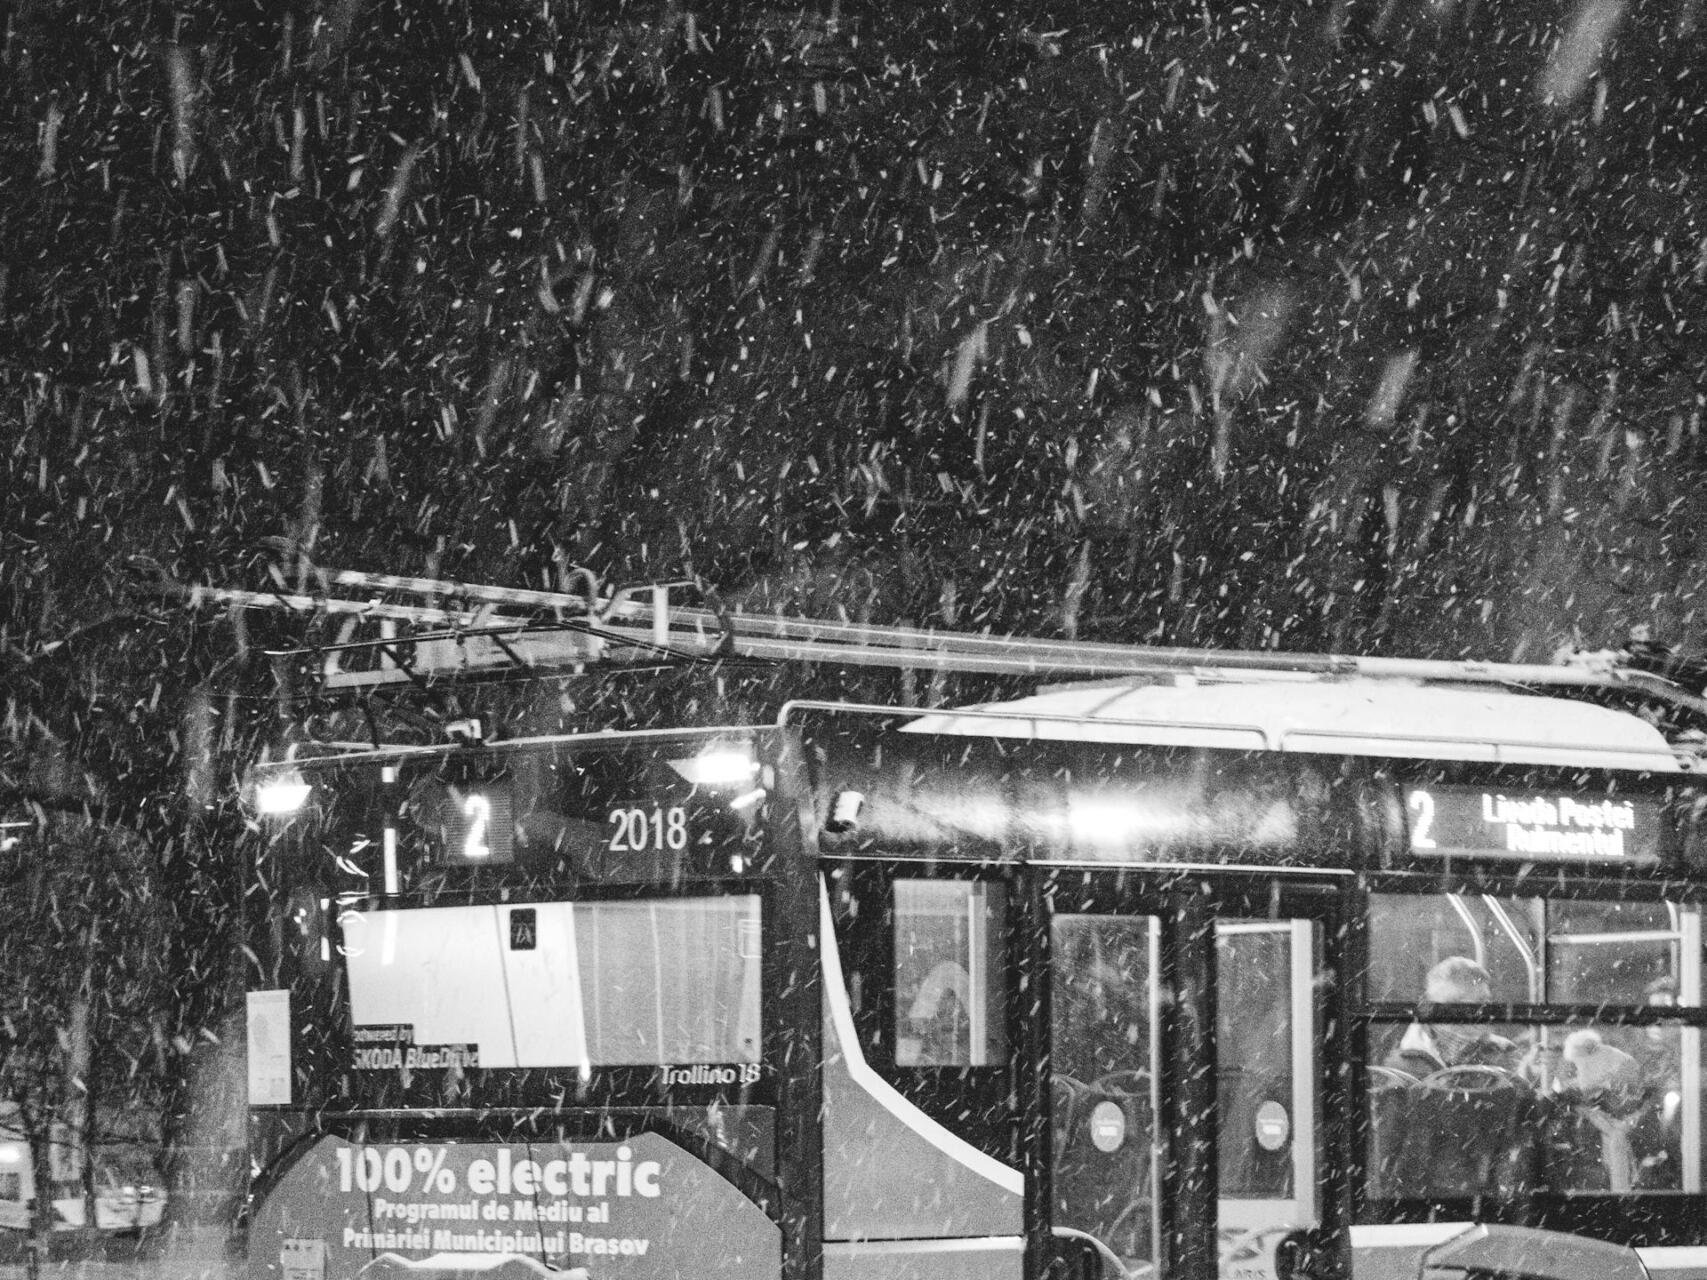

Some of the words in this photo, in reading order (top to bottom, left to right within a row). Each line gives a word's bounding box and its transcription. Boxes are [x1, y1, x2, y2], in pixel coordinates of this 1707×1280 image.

[463, 794, 490, 857] 2
[609, 807, 687, 851] 2018
[1409, 790, 1436, 848] 2
[660, 1064, 736, 1084] Trollino
[738, 1063, 761, 1082] 18
[336, 1147, 457, 1193] 100%
[467, 1146, 661, 1197] electric
[374, 1199, 480, 1223] Programul
[482, 1201, 510, 1221] de
[513, 1200, 583, 1222] Mediu
[586, 1202, 609, 1223] al
[433, 1229, 565, 1254] Municipiului
